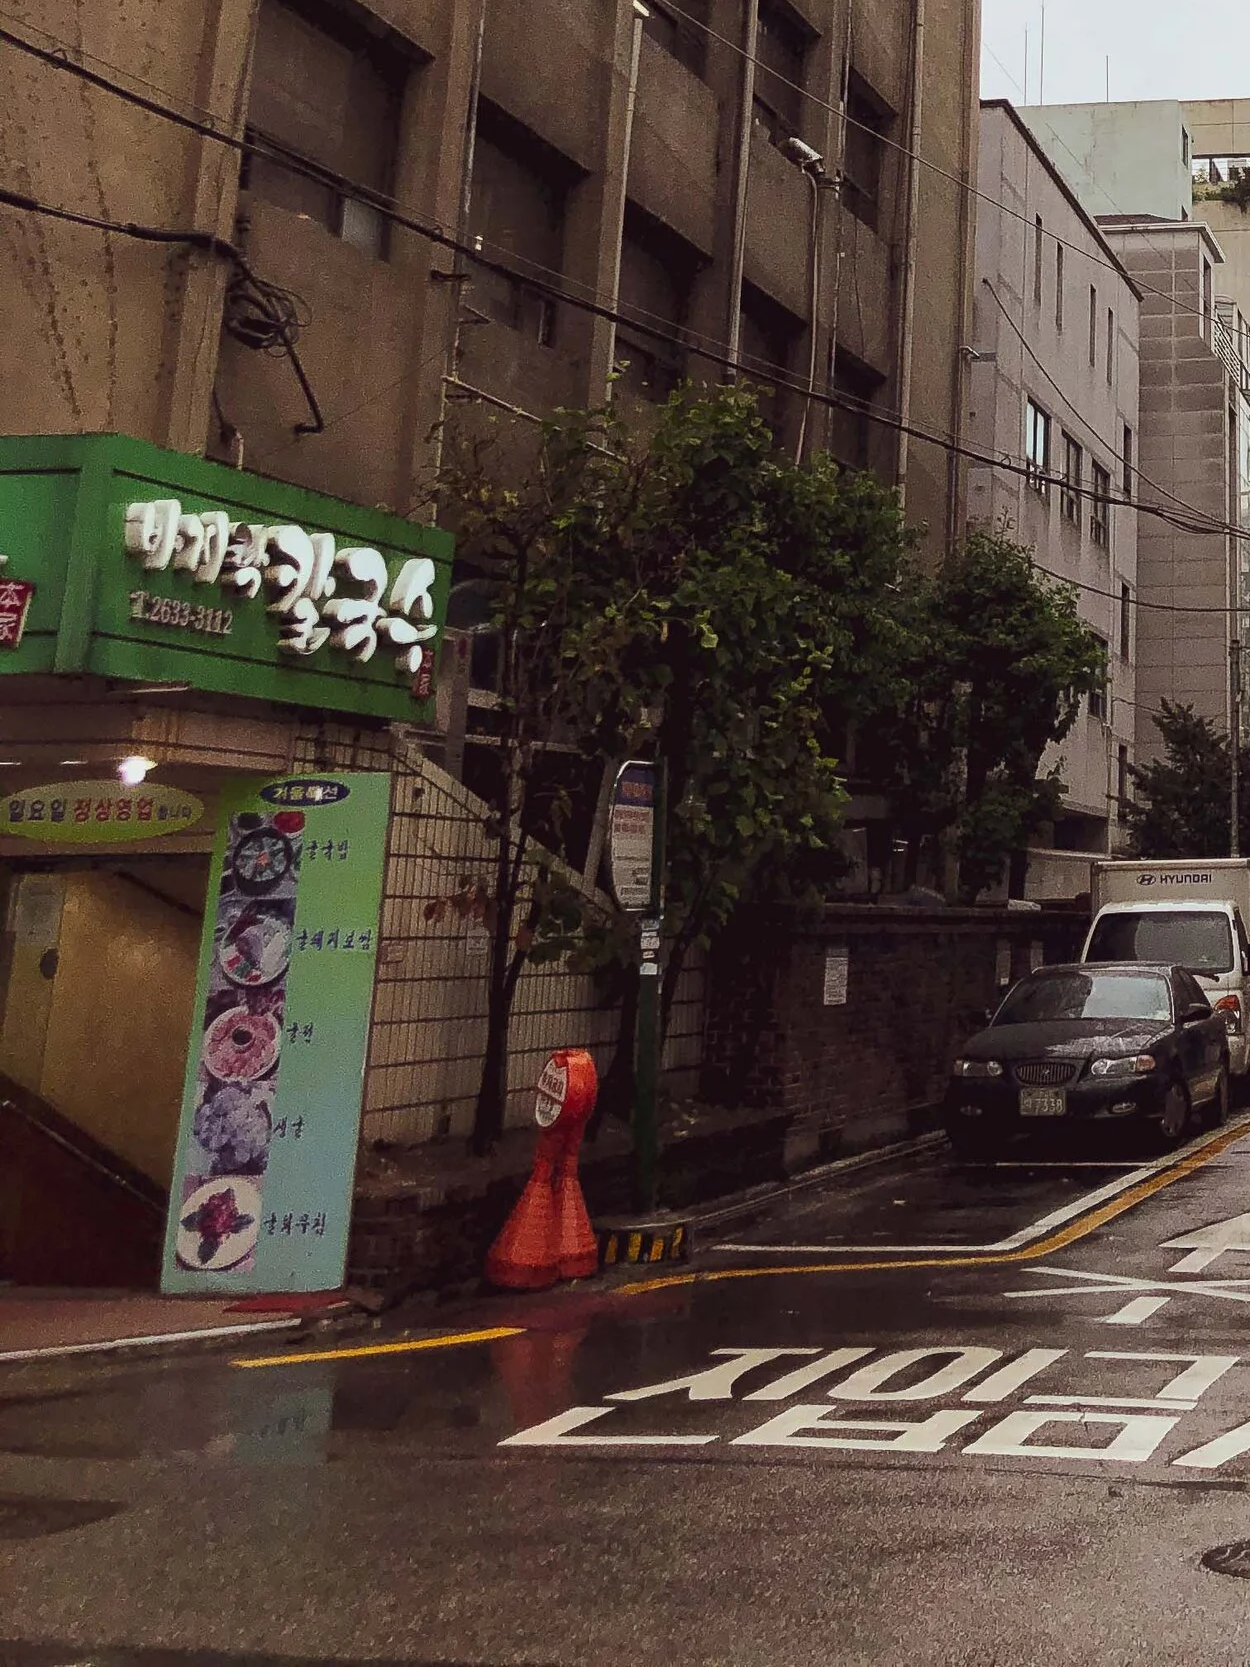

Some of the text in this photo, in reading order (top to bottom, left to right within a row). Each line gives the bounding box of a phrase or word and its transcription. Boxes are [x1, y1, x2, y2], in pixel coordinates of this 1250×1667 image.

[9, 798, 68, 822] 일요일
[73, 796, 153, 822] 정상영업
[1160, 873, 1212, 884] HYUNDAI
